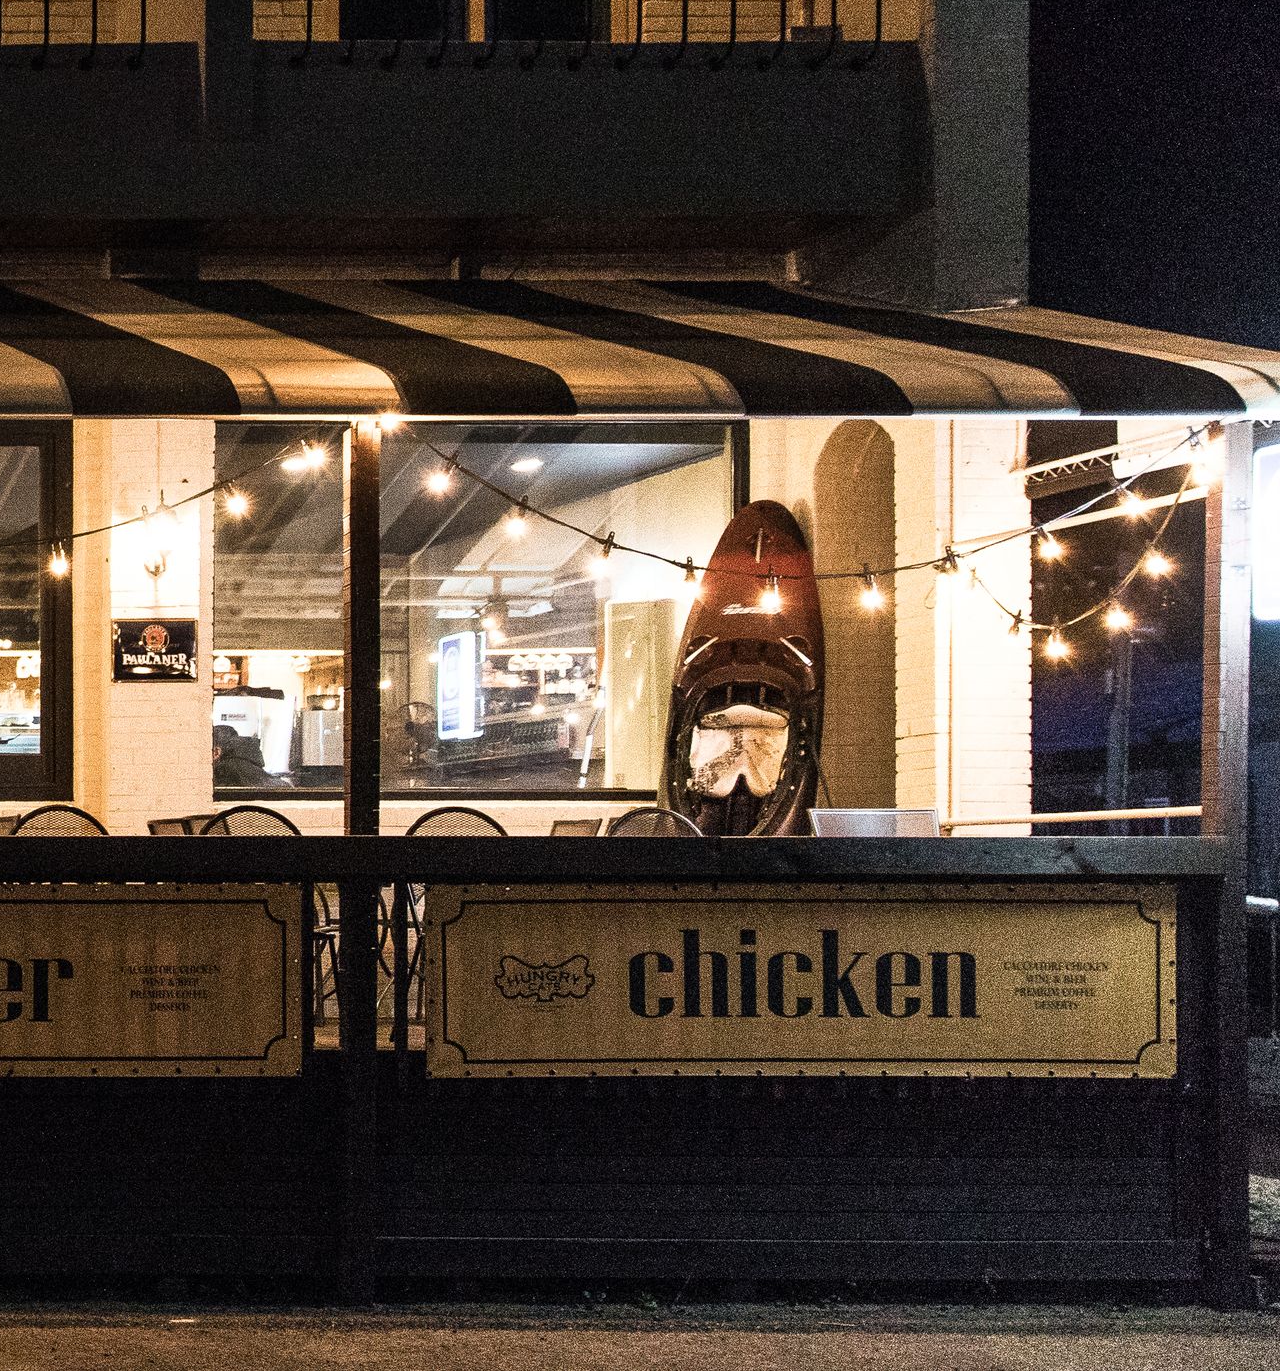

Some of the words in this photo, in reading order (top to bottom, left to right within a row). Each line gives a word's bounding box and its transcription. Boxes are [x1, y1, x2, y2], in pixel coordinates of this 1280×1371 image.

[122, 653, 187, 666] PAULANER
[507, 970, 580, 986] HUNGRY
[628, 928, 981, 1020] chicken
